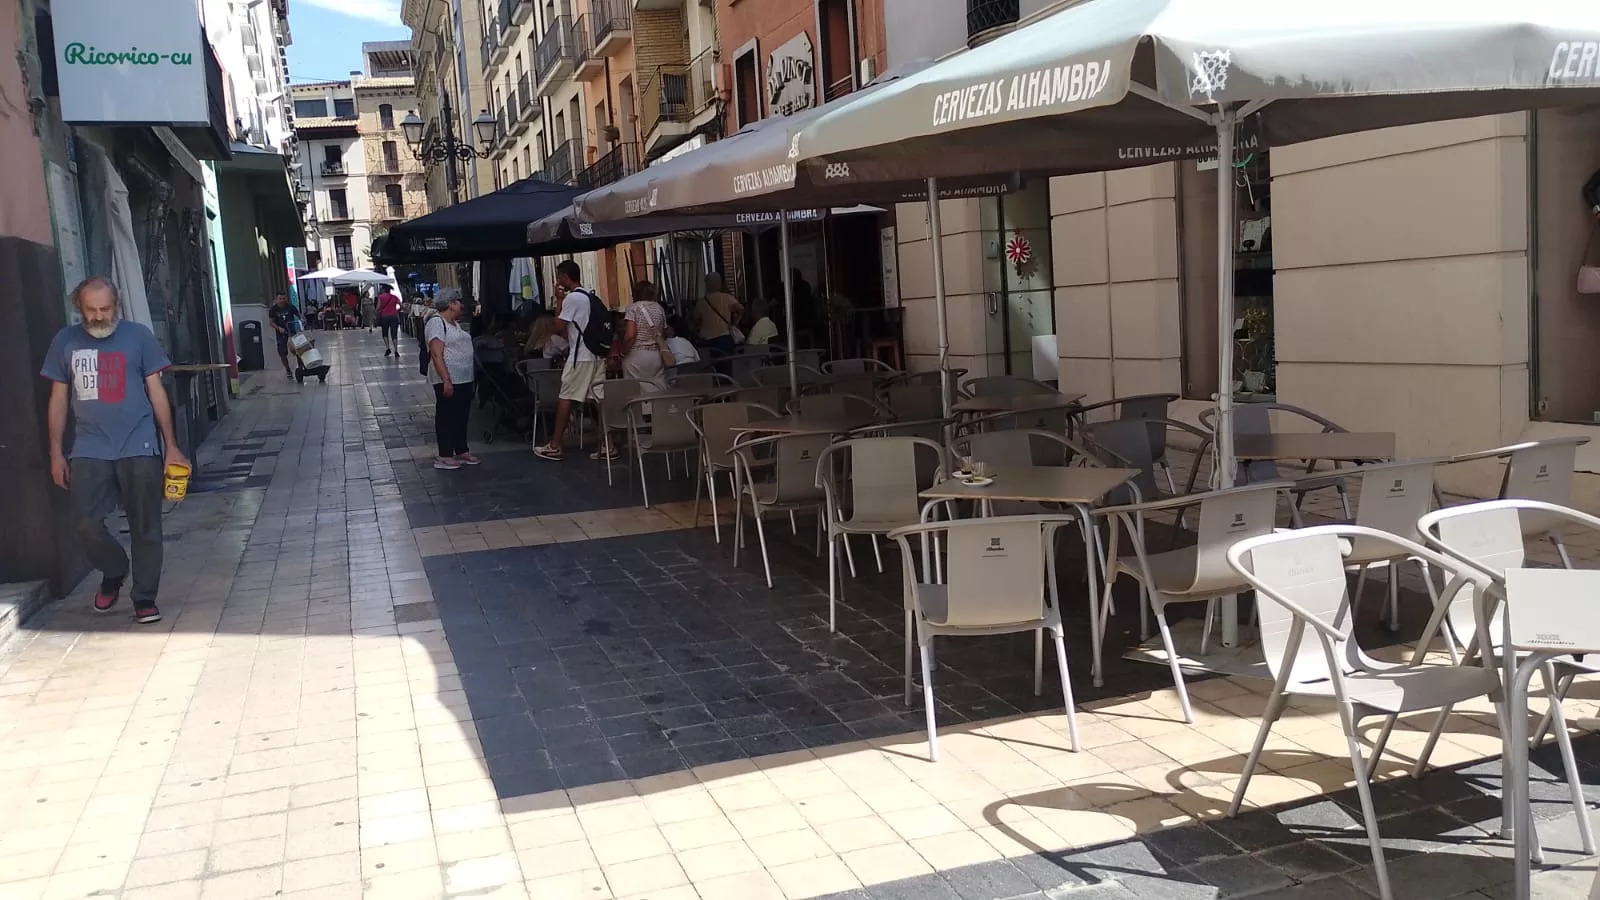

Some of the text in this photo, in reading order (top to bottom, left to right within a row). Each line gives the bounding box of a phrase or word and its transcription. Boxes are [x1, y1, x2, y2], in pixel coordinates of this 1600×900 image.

[64, 42, 192, 65] Ricorico-cu
[1549, 41, 1600, 78] CER
[932, 59, 1111, 127] CERVEZAS ALHAMBRA
[733, 171, 762, 194] CERVEZAS
[736, 208, 817, 223] CERVEZAS AAMBRA
